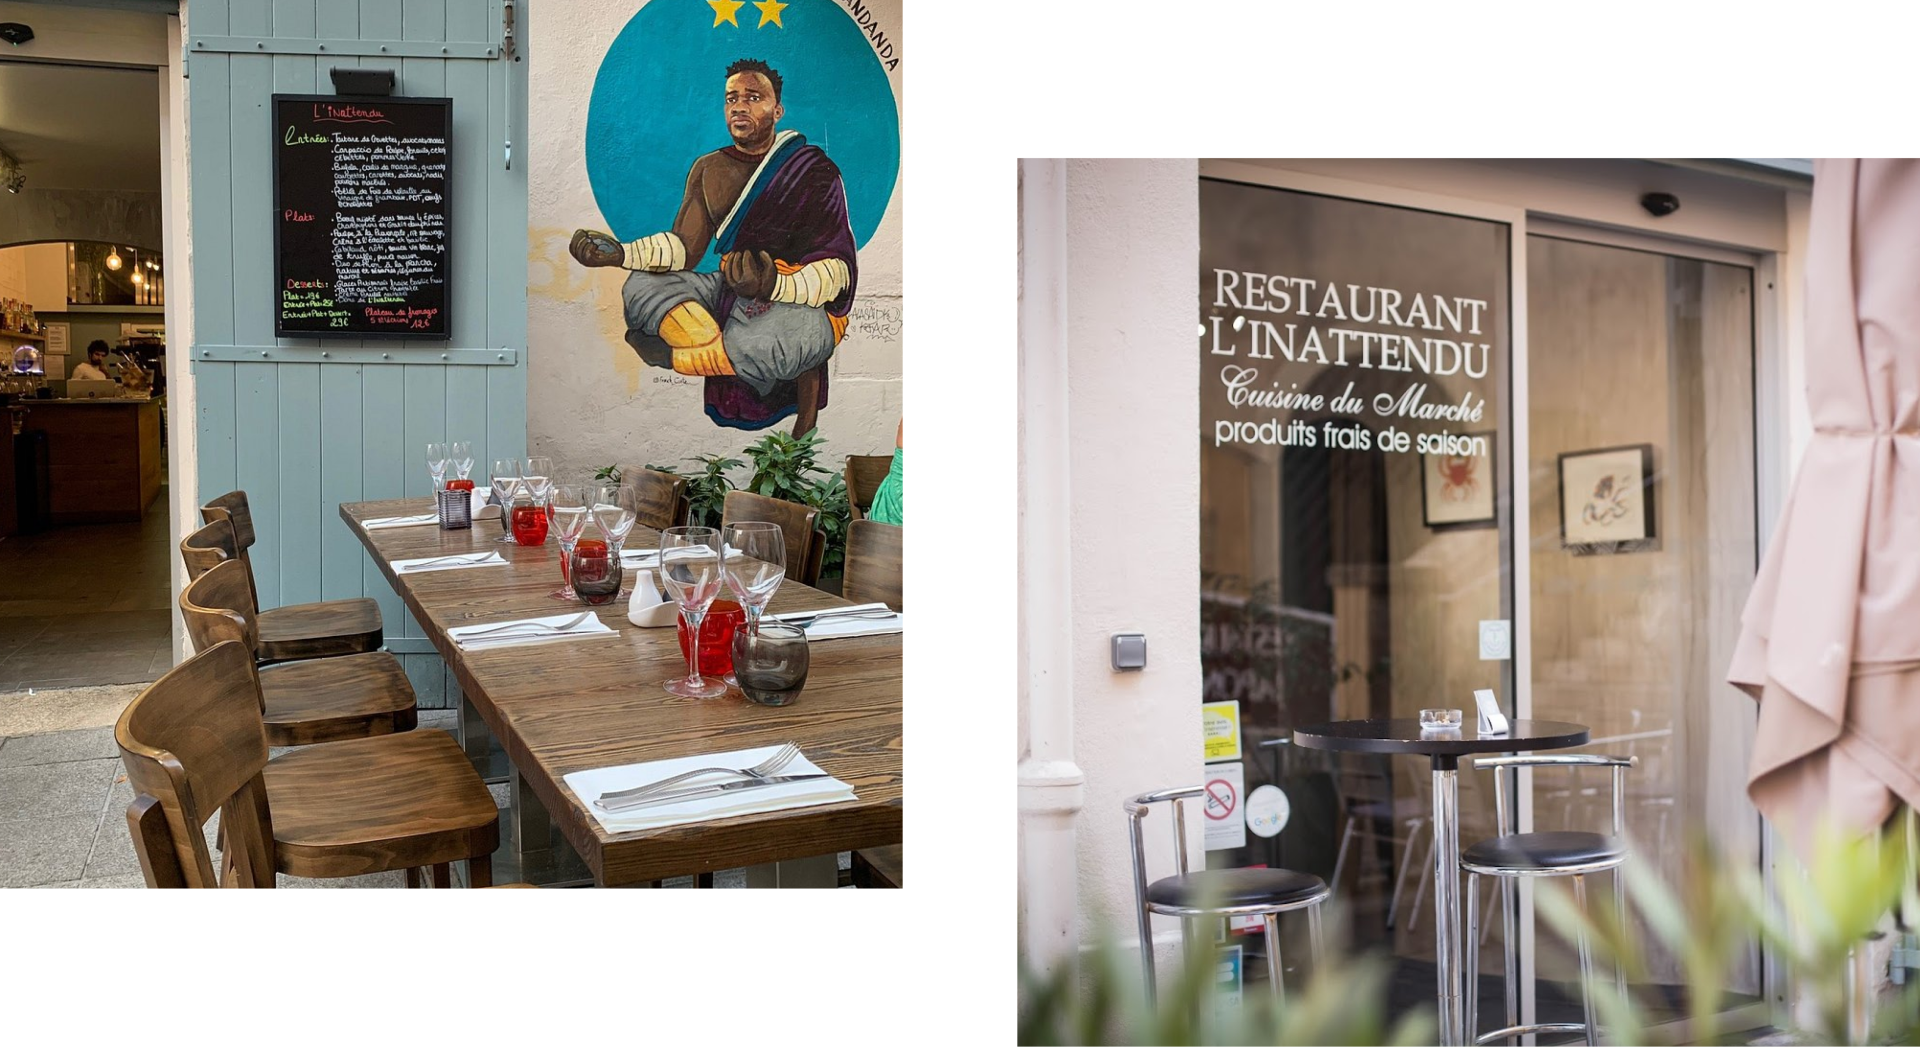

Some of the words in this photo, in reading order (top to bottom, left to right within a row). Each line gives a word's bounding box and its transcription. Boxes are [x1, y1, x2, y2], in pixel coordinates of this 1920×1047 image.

[1212, 268, 1487, 335] RESTAURANT
[1209, 316, 1490, 379] L'INATTENDU
[1220, 364, 1325, 411] Cuisine
[1330, 381, 1364, 415] du
[1373, 382, 1485, 423] Marché
[1215, 418, 1317, 448] produits
[1323, 421, 1371, 451] frais
[1377, 426, 1411, 453] de
[1416, 430, 1486, 457] saison
